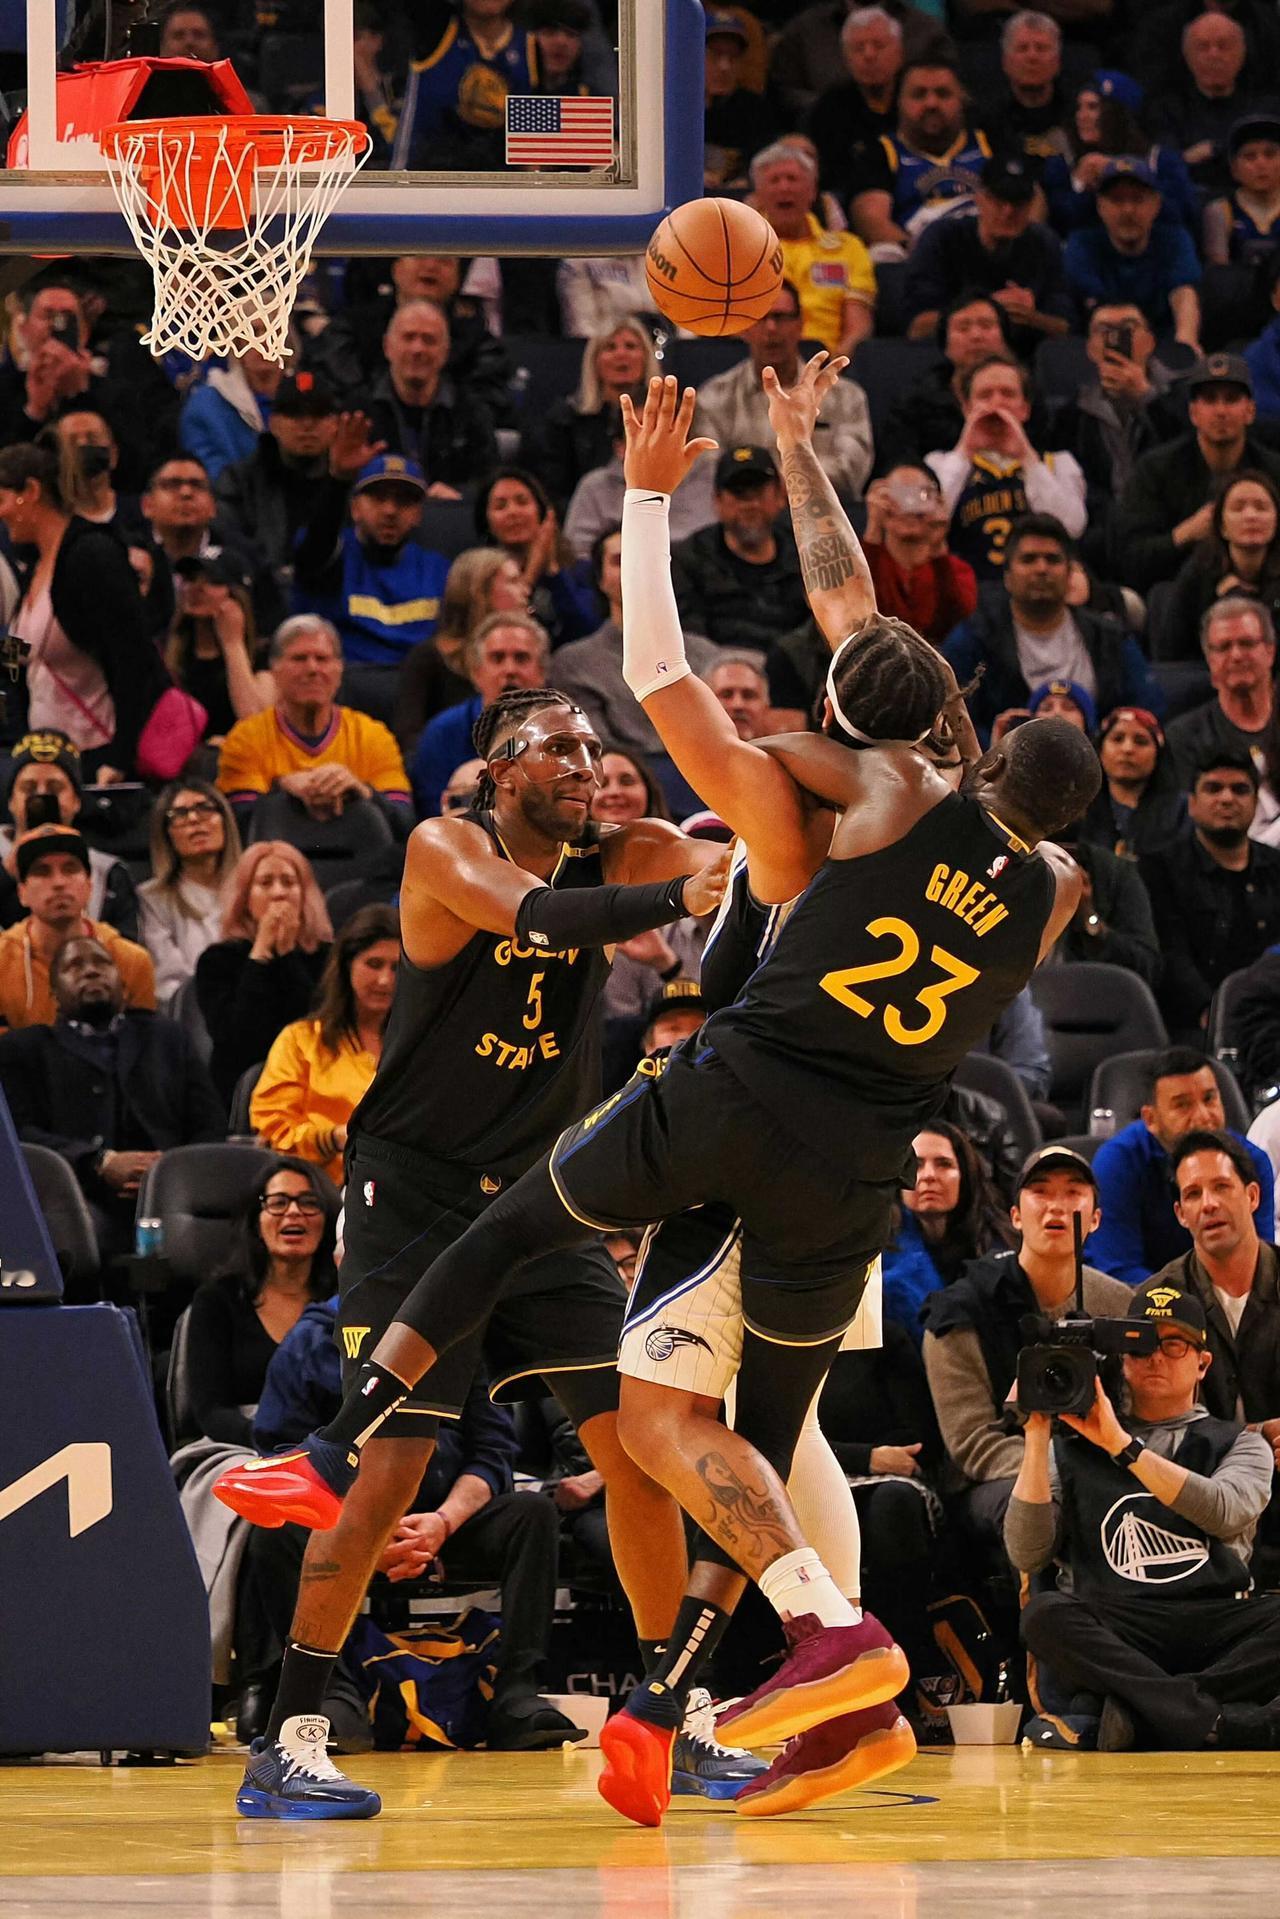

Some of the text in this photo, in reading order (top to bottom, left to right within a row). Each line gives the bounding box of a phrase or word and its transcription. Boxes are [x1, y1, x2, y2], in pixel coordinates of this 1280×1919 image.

[925, 863, 1009, 937] GREEN
[522, 971, 545, 1030] 5
[819, 916, 981, 1045] 23
[342, 1327, 371, 1359] W
